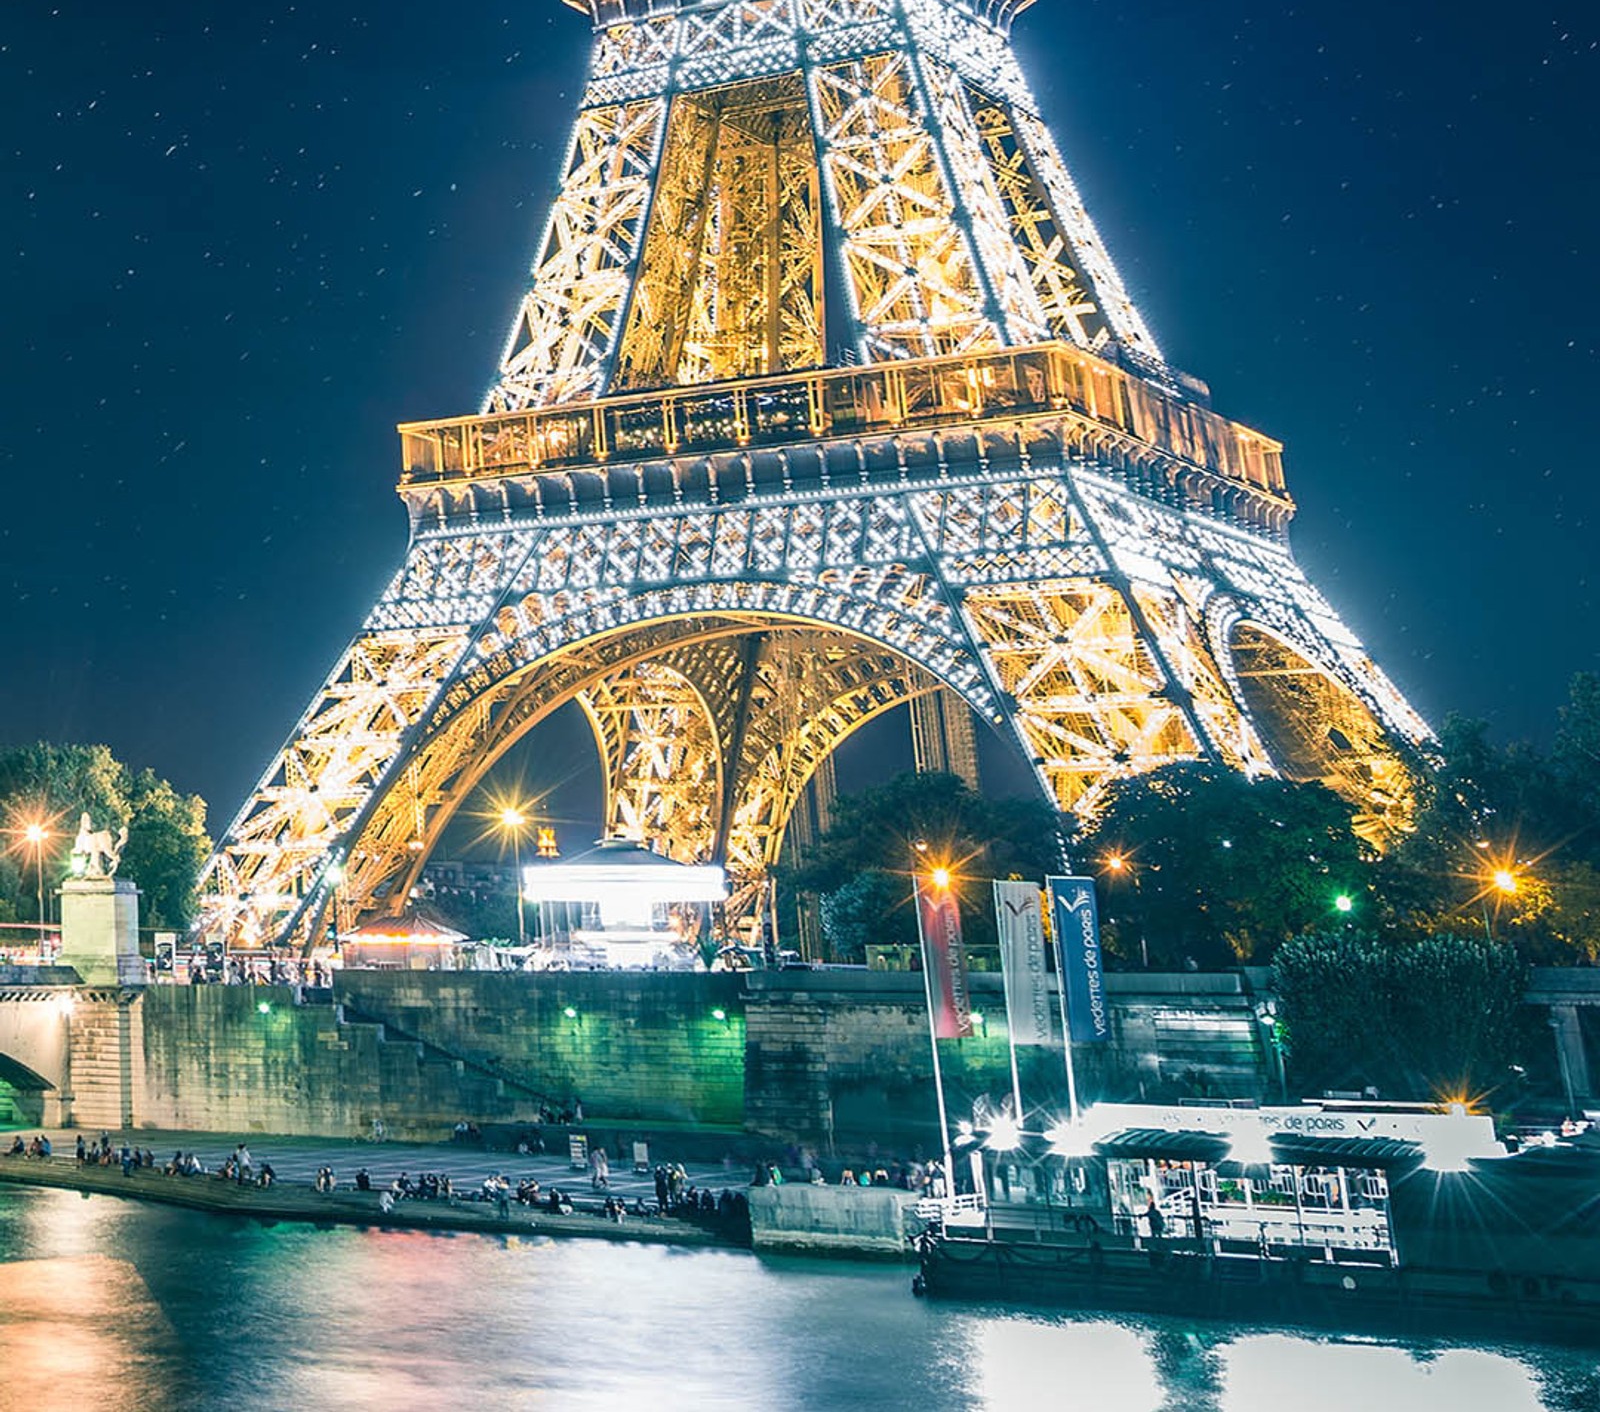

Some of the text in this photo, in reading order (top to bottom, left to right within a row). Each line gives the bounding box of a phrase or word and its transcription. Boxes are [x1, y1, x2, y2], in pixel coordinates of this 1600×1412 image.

[947, 947, 960, 966] de
[1027, 954, 1041, 973] de
[1081, 909, 1107, 1036] vedettes de paris
[1031, 974, 1048, 1040] vedettes
[1284, 1115, 1302, 1130] de
[1306, 1116, 1345, 1132] paris
